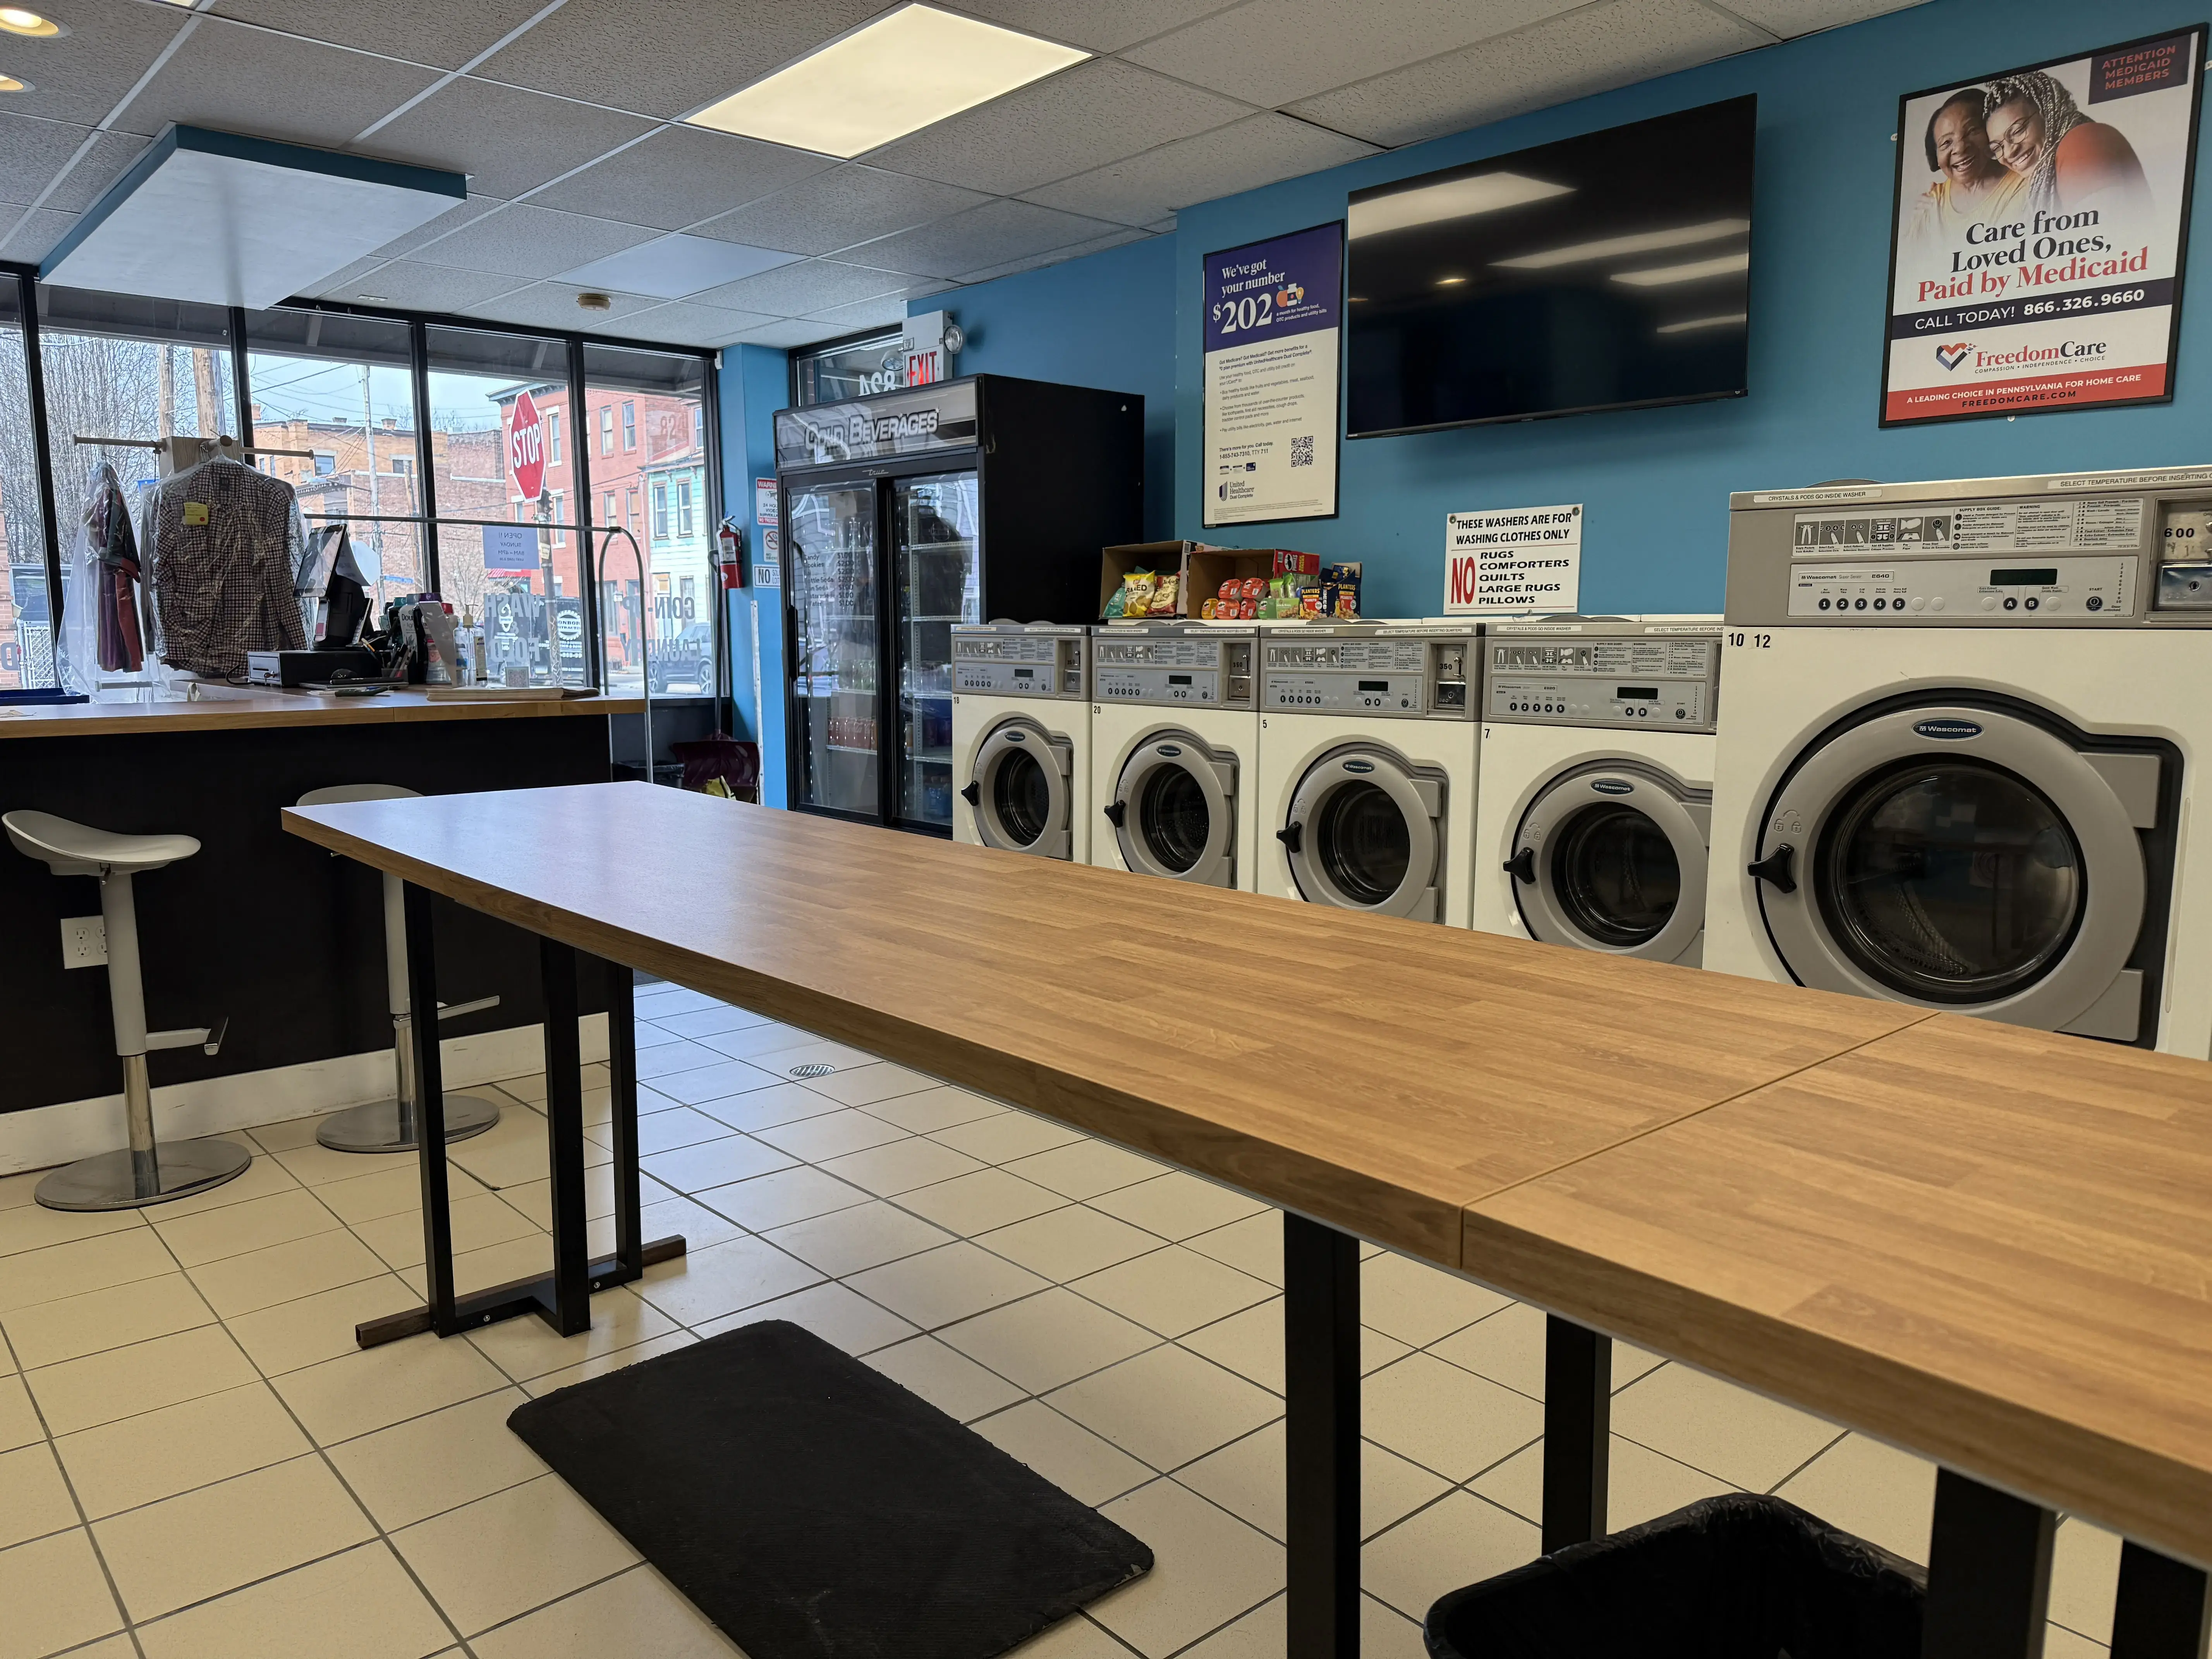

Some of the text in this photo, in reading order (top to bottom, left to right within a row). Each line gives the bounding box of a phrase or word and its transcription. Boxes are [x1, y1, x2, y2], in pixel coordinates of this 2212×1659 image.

[2102, 45, 2176, 69] ATTENTION
[2105, 58, 2171, 79] MEDICAID
[2105, 68, 2169, 90] MEMBERS
[1966, 210, 2099, 245] Care from
[1951, 235, 2112, 273] Loved Ones,
[1222, 259, 1267, 279] We've got
[1917, 246, 2148, 302] Paid by Medicaid
[1222, 271, 1285, 298] your number
[1213, 293, 1273, 334] $202
[1915, 289, 2145, 330] CALL TODAY! 866.326.9660
[1975, 341, 2107, 367] FreedomCare
[909, 351, 937, 387] EXIT
[1975, 365, 2015, 373] COMPASSION
[2022, 359, 2072, 369] INDEPENDENCE
[1914, 393, 1950, 402] LEADING
[1952, 390, 1984, 398] CHOICE
[1996, 382, 2063, 395] PENNSYLVANIA
[2065, 380, 2083, 388] FOR
[2086, 377, 2114, 386] HOME
[2116, 374, 2141, 383] CARE
[1961, 390, 2076, 407] FREEDOMCARE.COM
[849, 410, 938, 445] BEVERAGES
[512, 422, 541, 469] STOP
[2088, 477, 2138, 485] TEMPERATURE
[1457, 513, 1571, 529] THESE WASHERS ARE FOR
[1456, 529, 1570, 544] WASHING CLOTHES ONLY
[2164, 528, 2194, 538] 600
[1480, 551, 1514, 559] RUGS
[1480, 560, 1569, 570] COMFORTERS
[758, 568, 770, 584] NO
[1451, 556, 1475, 604] NO
[1479, 573, 1525, 581] QUILTS
[1525, 584, 1560, 592] RUGS
[1479, 596, 1535, 604] PILLOWS
[1728, 632, 1771, 648] 10 12
[1094, 706, 1101, 714] 20
[1263, 720, 1267, 728] 5
[1484, 728, 1490, 738] 7
